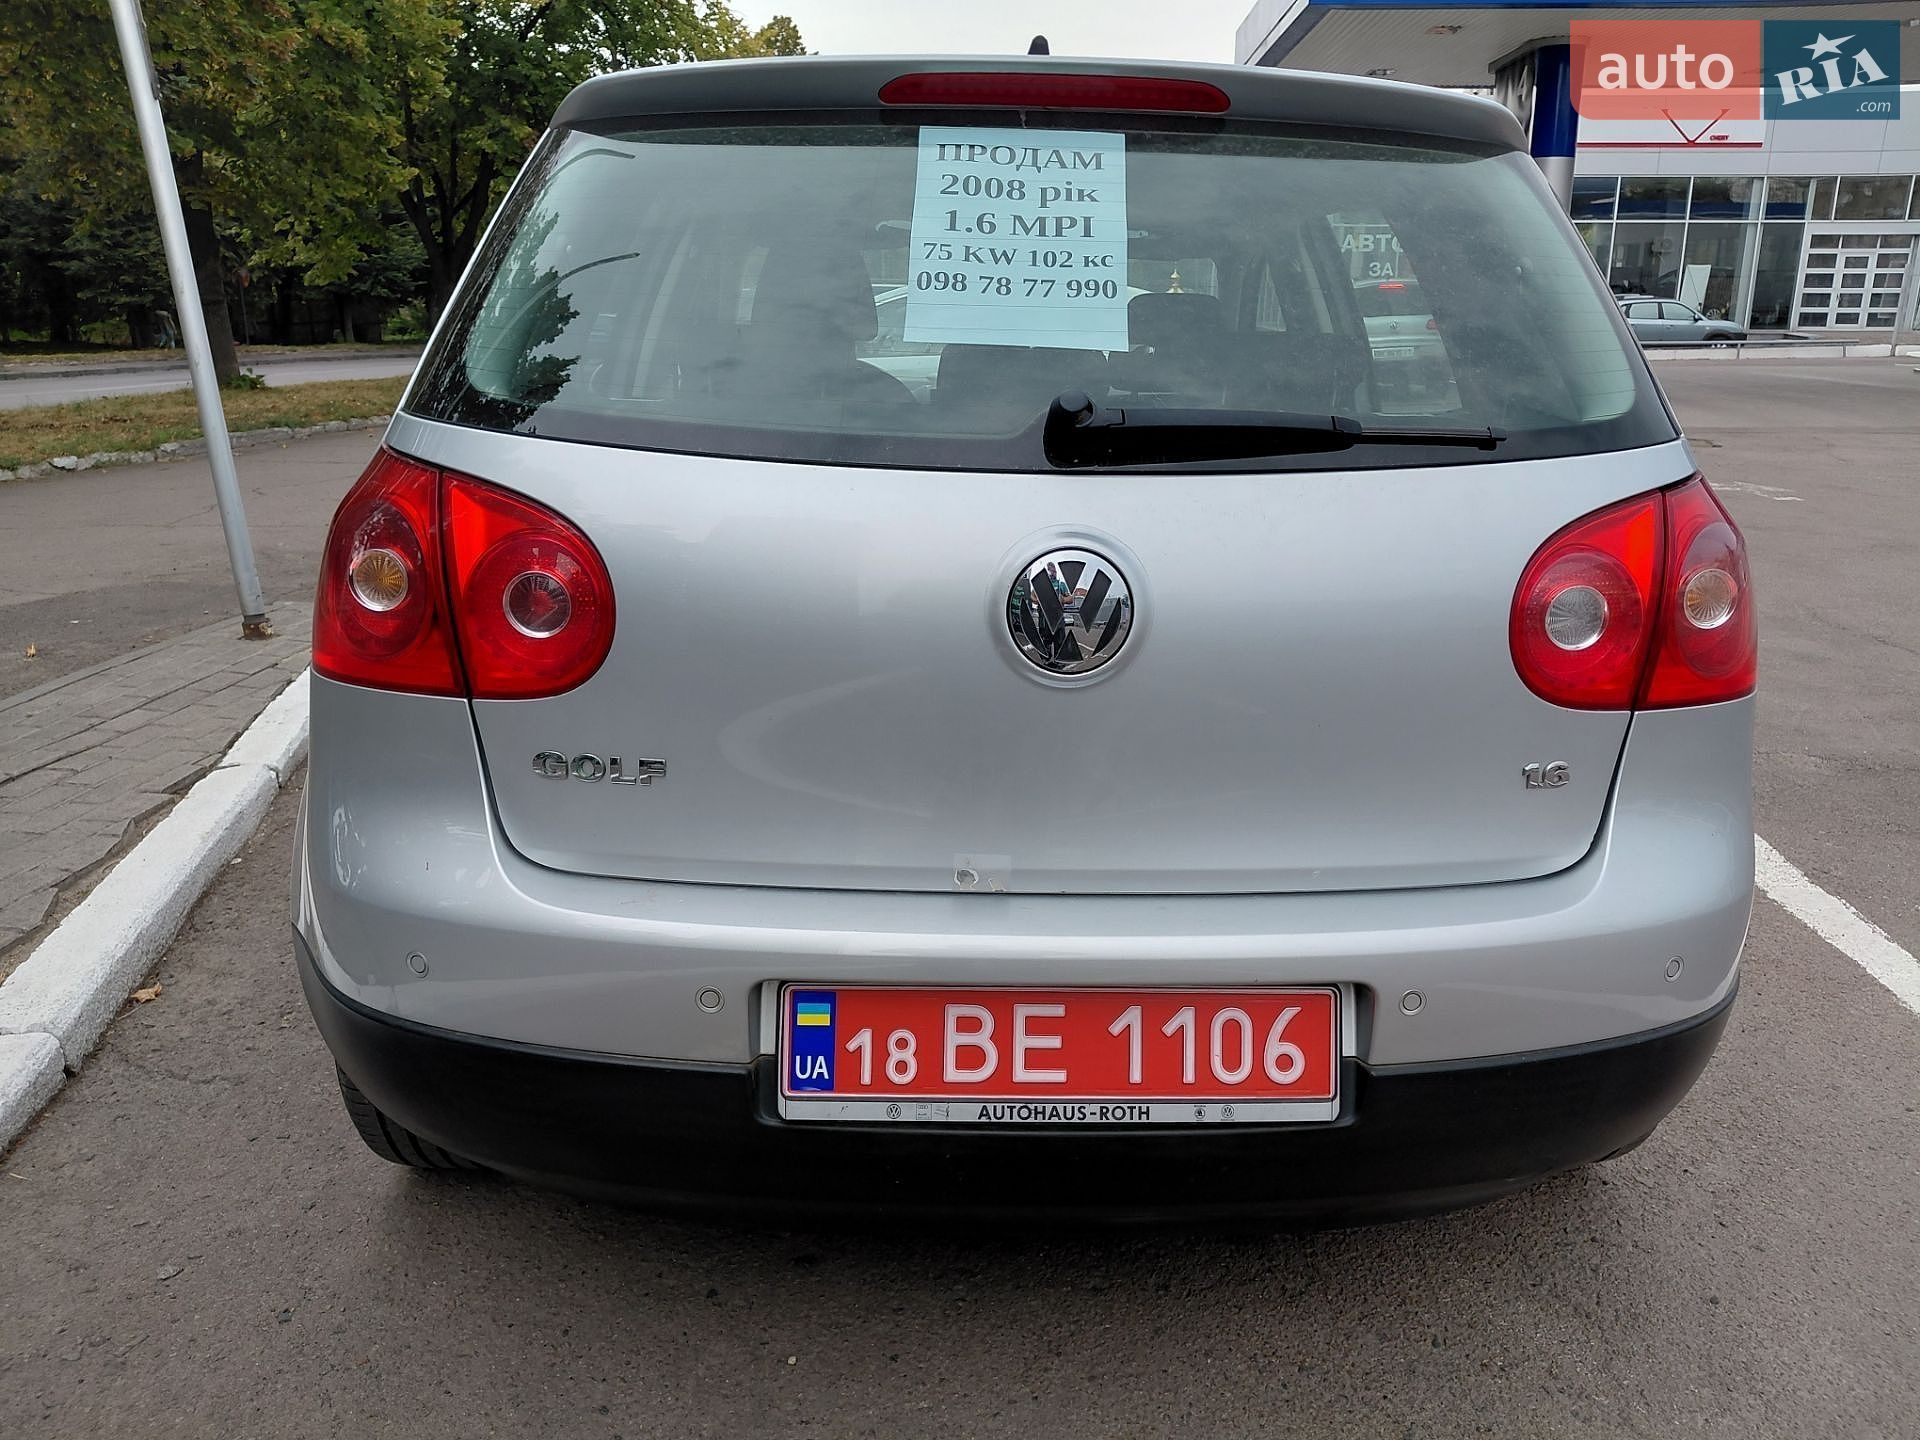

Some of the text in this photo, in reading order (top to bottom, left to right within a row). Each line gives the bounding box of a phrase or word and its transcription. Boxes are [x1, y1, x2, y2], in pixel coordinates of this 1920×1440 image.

[936, 143, 1104, 173] ПРОДАМ
[939, 173, 1100, 209] 2008 рік
[944, 209, 1095, 238] 1.6 MPI
[923, 242, 953, 261] 75
[961, 245, 1018, 266] KW
[1028, 250, 1074, 268] 102
[916, 271, 1118, 299] 098 78 77 990
[532, 750, 666, 786] GOLF
[845, 1003, 1306, 1085] 18 BE 1106
[795, 1055, 830, 1079] UA
[977, 1104, 1150, 1122] AUTOHAUS-ROTH
